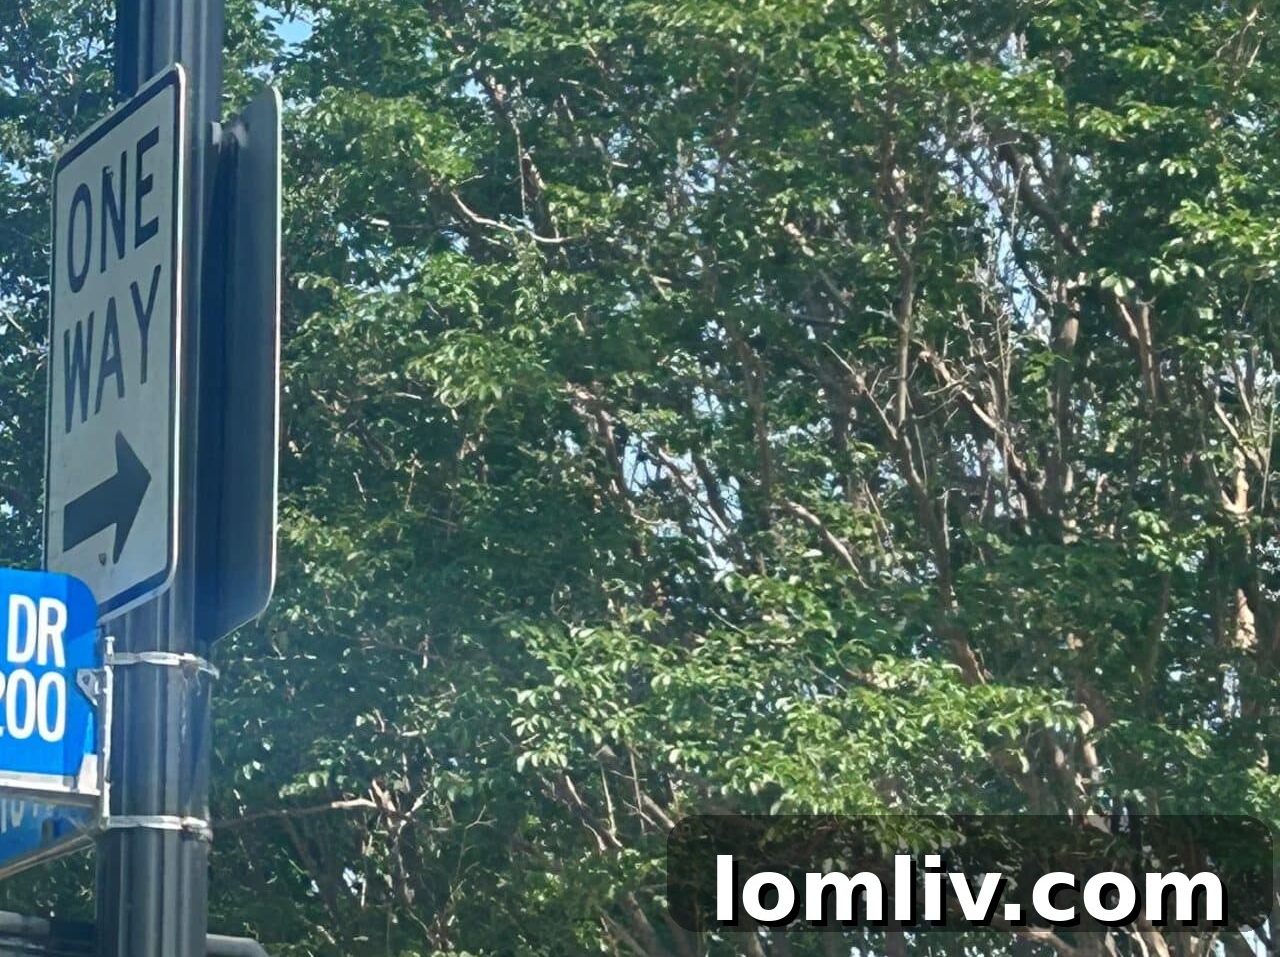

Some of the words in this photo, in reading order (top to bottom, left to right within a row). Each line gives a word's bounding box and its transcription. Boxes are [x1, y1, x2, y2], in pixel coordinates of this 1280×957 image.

[67, 126, 160, 294] ONE
[63, 264, 161, 434] WAY
[7, 594, 68, 668] DR
